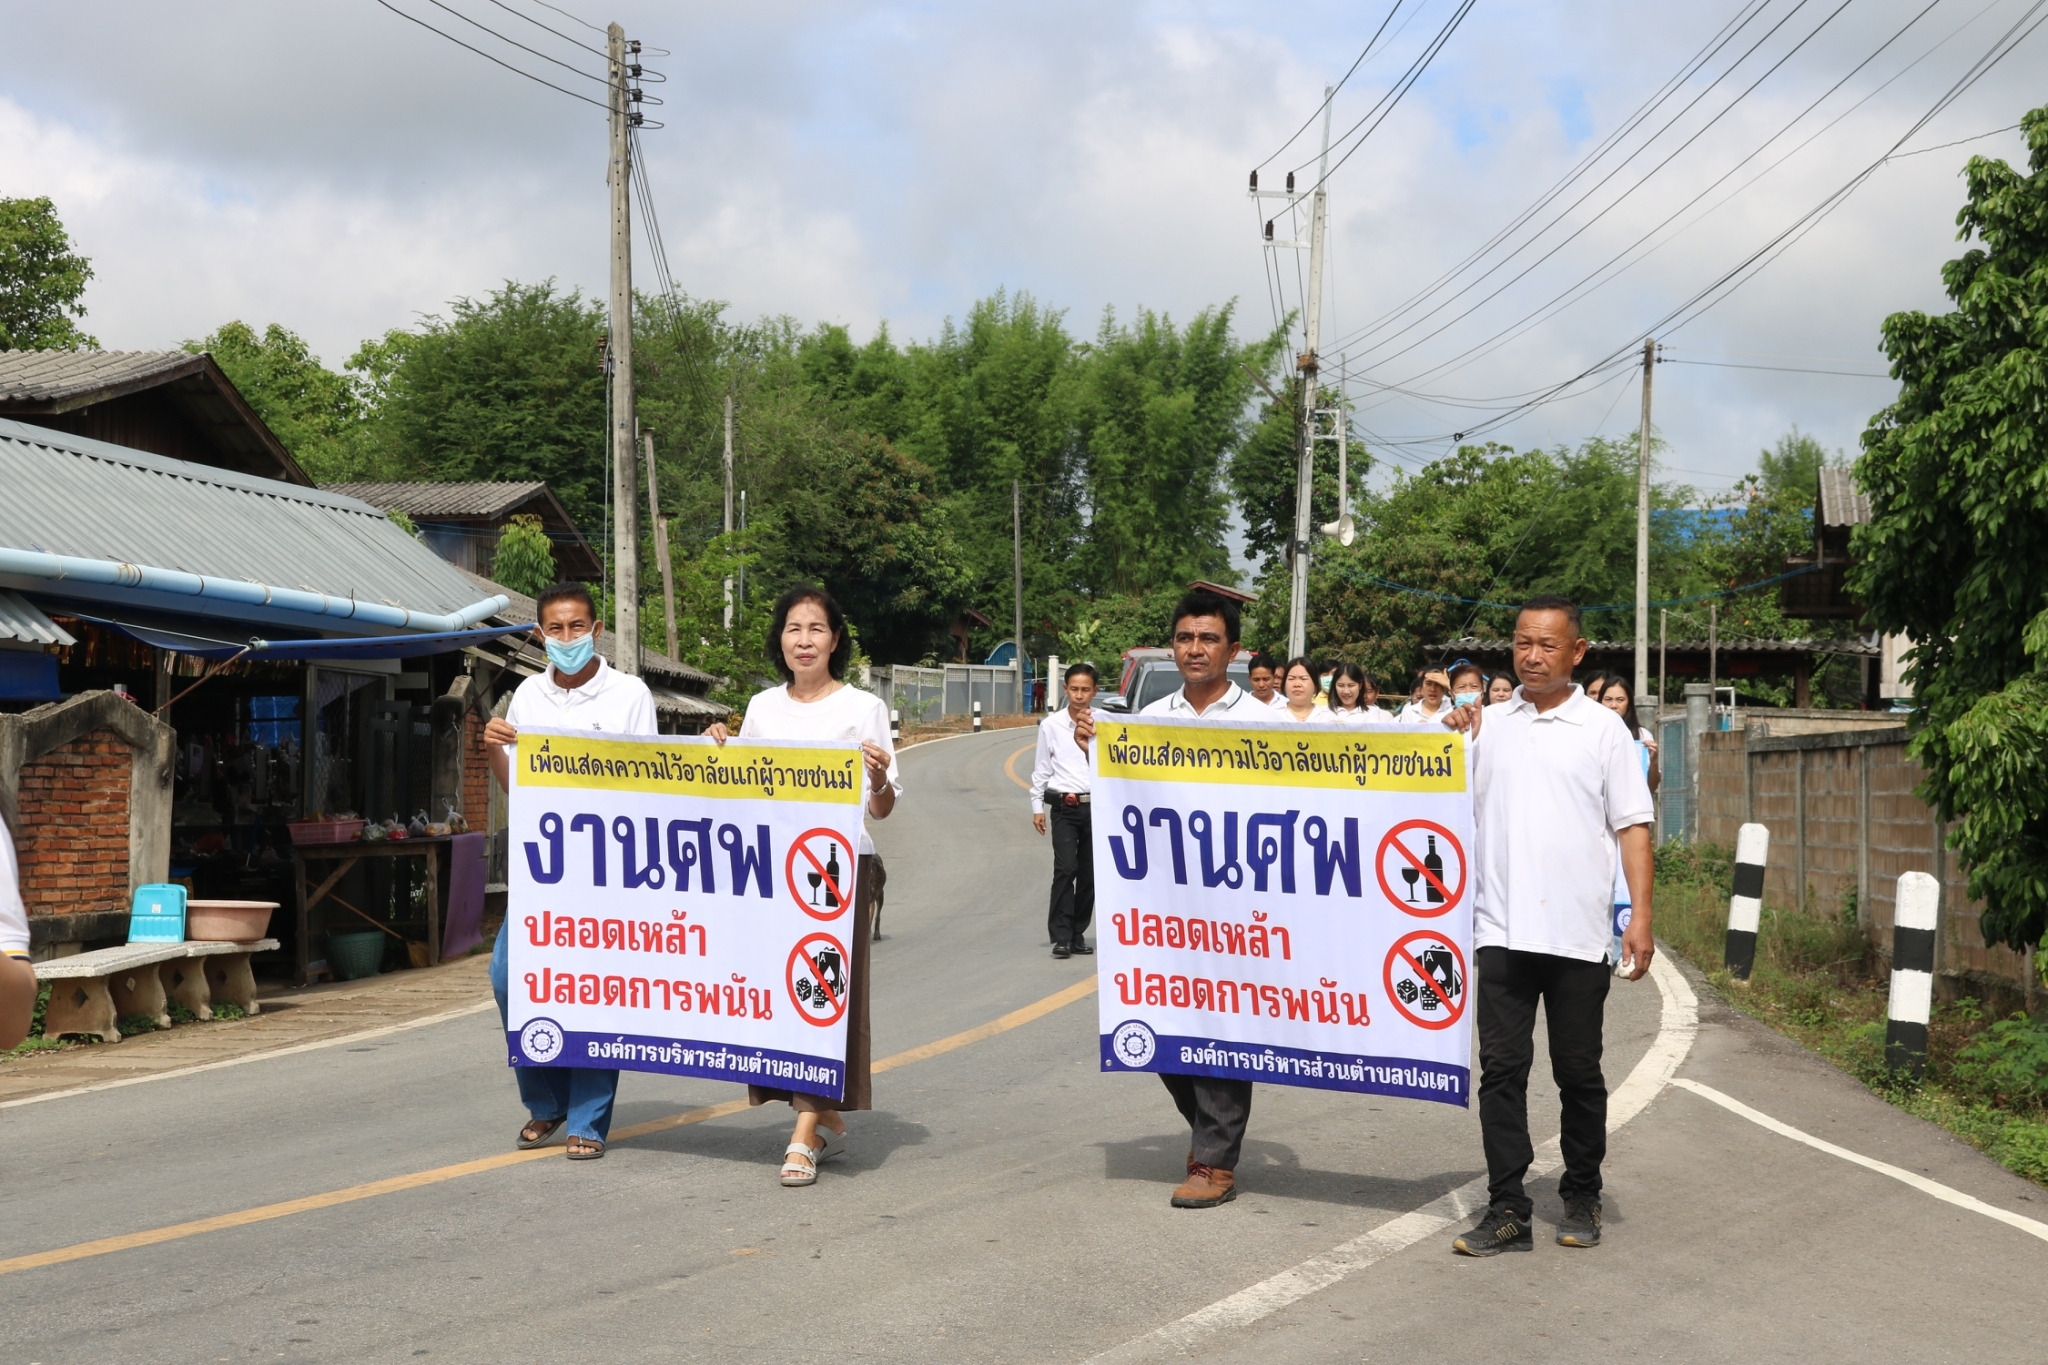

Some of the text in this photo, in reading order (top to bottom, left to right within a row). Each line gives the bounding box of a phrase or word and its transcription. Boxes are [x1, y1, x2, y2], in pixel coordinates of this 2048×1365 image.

[530, 739, 854, 796] เพื่อแสดงความไว้อาลัยแก่ผู้วายชนม์
[1108, 728, 1453, 786] เพื่อแสดงความไว้อาลัยแก่ผู้วายชนม์
[523, 811, 774, 899] งานศพ
[1108, 805, 1362, 898] งานศพ
[524, 909, 706, 957] ปลอดเหล้า
[1111, 908, 1291, 961] ปลอดเหล้า
[524, 967, 773, 1021] ปลอดการพนัน
[1114, 968, 1371, 1027] ปลอดการพนัน
[587, 1035, 838, 1086] องค์การบริหารส่วนตำบลปงเตา
[1180, 1042, 1459, 1093] องค์การบริหารส่วนตำบลปงเตา
